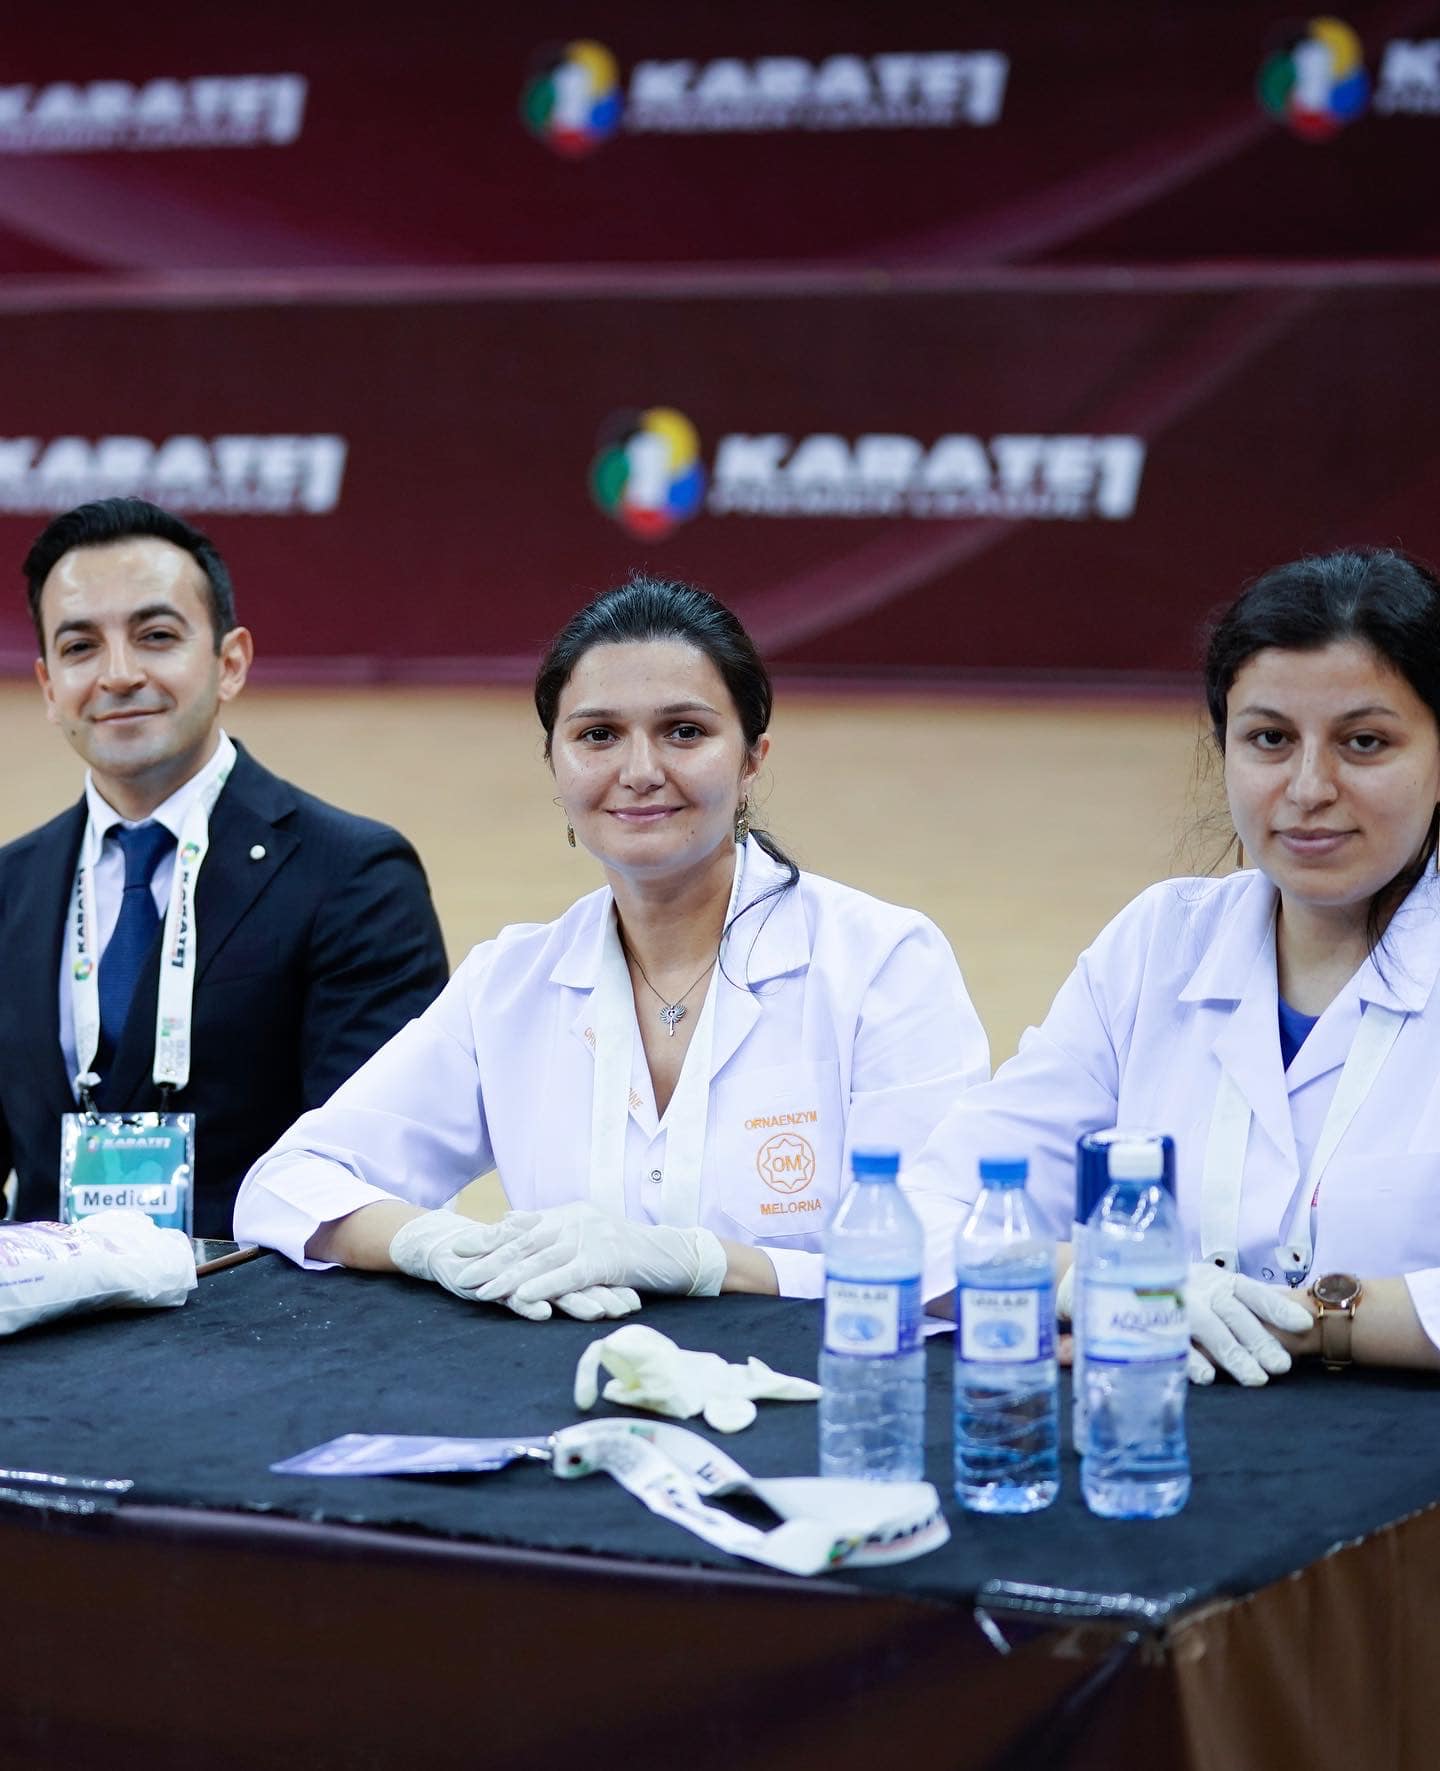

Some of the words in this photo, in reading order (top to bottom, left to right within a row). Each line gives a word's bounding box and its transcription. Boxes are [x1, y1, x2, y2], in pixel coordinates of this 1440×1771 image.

[714, 434, 1146, 519] KARATE1
[744, 1111, 817, 1130] ORNAENZYM
[772, 1154, 802, 1173] OM
[83, 1190, 167, 1207] Medical
[760, 1199, 822, 1215] MELORNA
